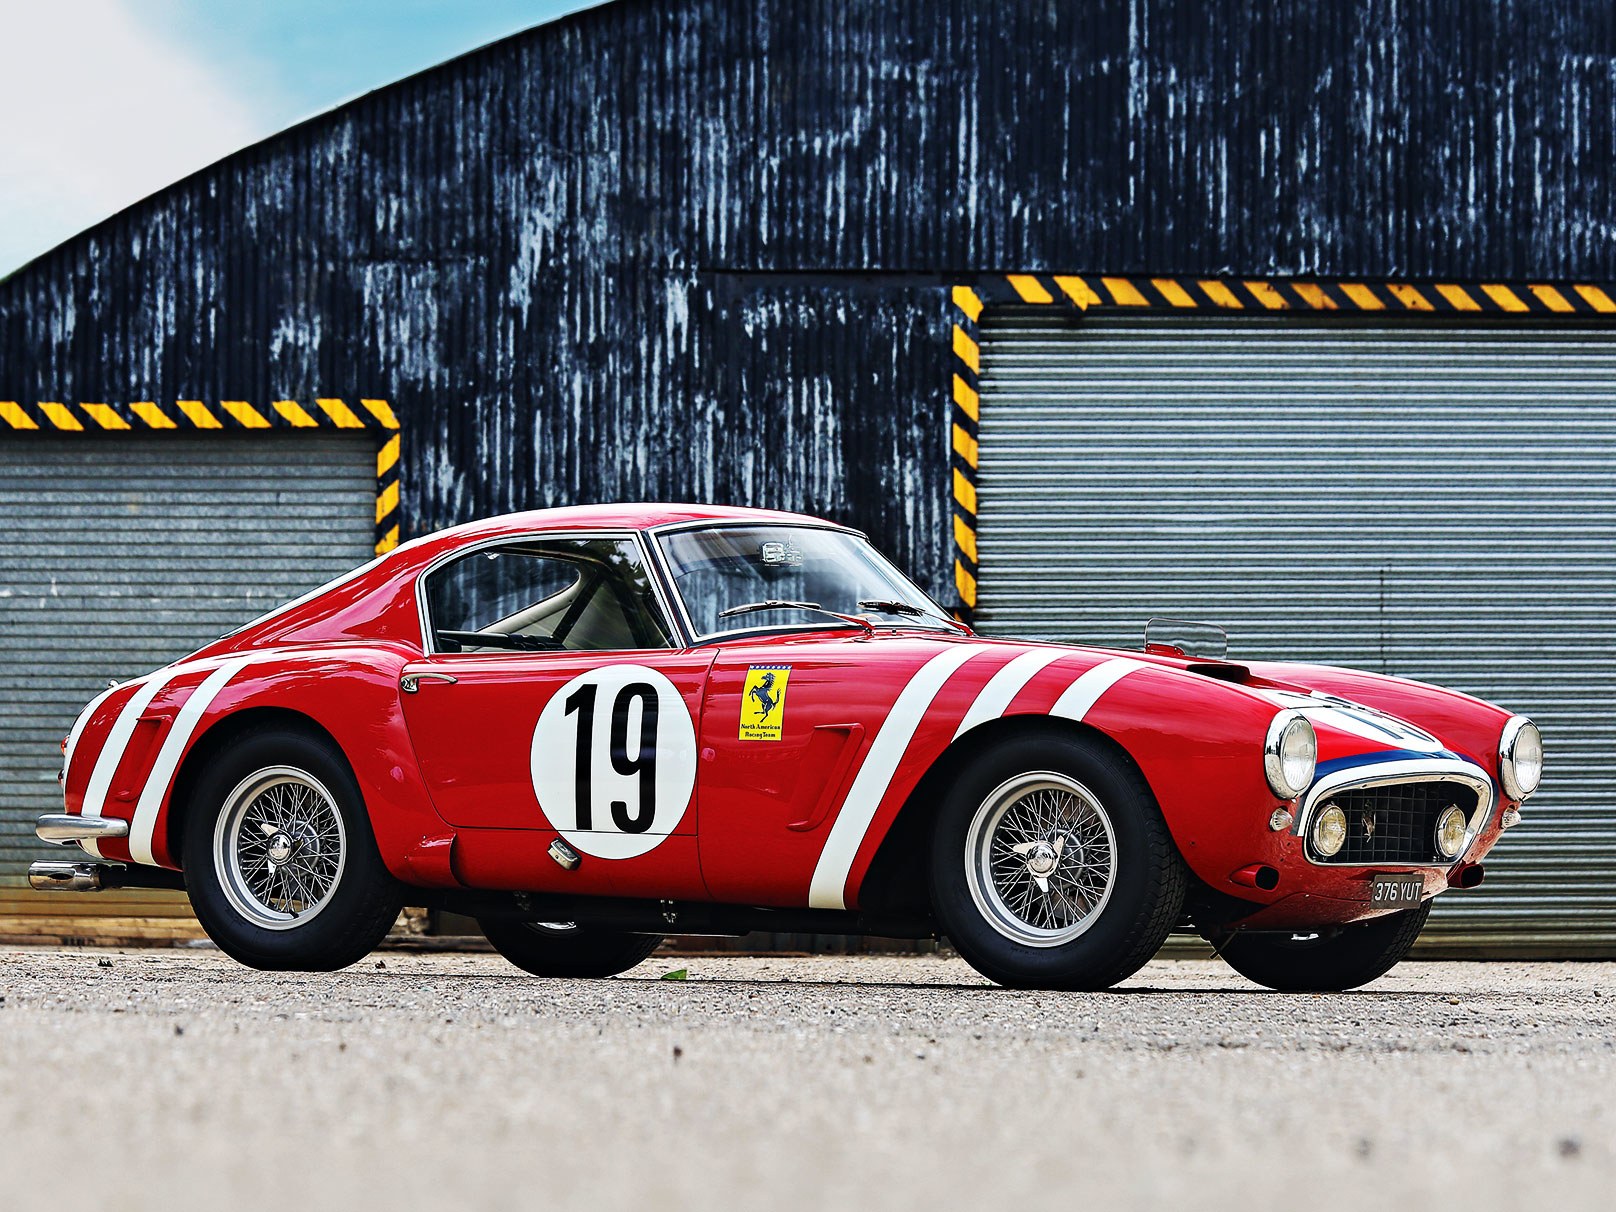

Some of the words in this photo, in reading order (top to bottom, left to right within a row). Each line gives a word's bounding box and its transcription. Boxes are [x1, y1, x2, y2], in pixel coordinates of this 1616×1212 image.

[564, 682, 659, 834] 19
[1374, 882, 1398, 901] 376
[1400, 882, 1421, 901] YUT
